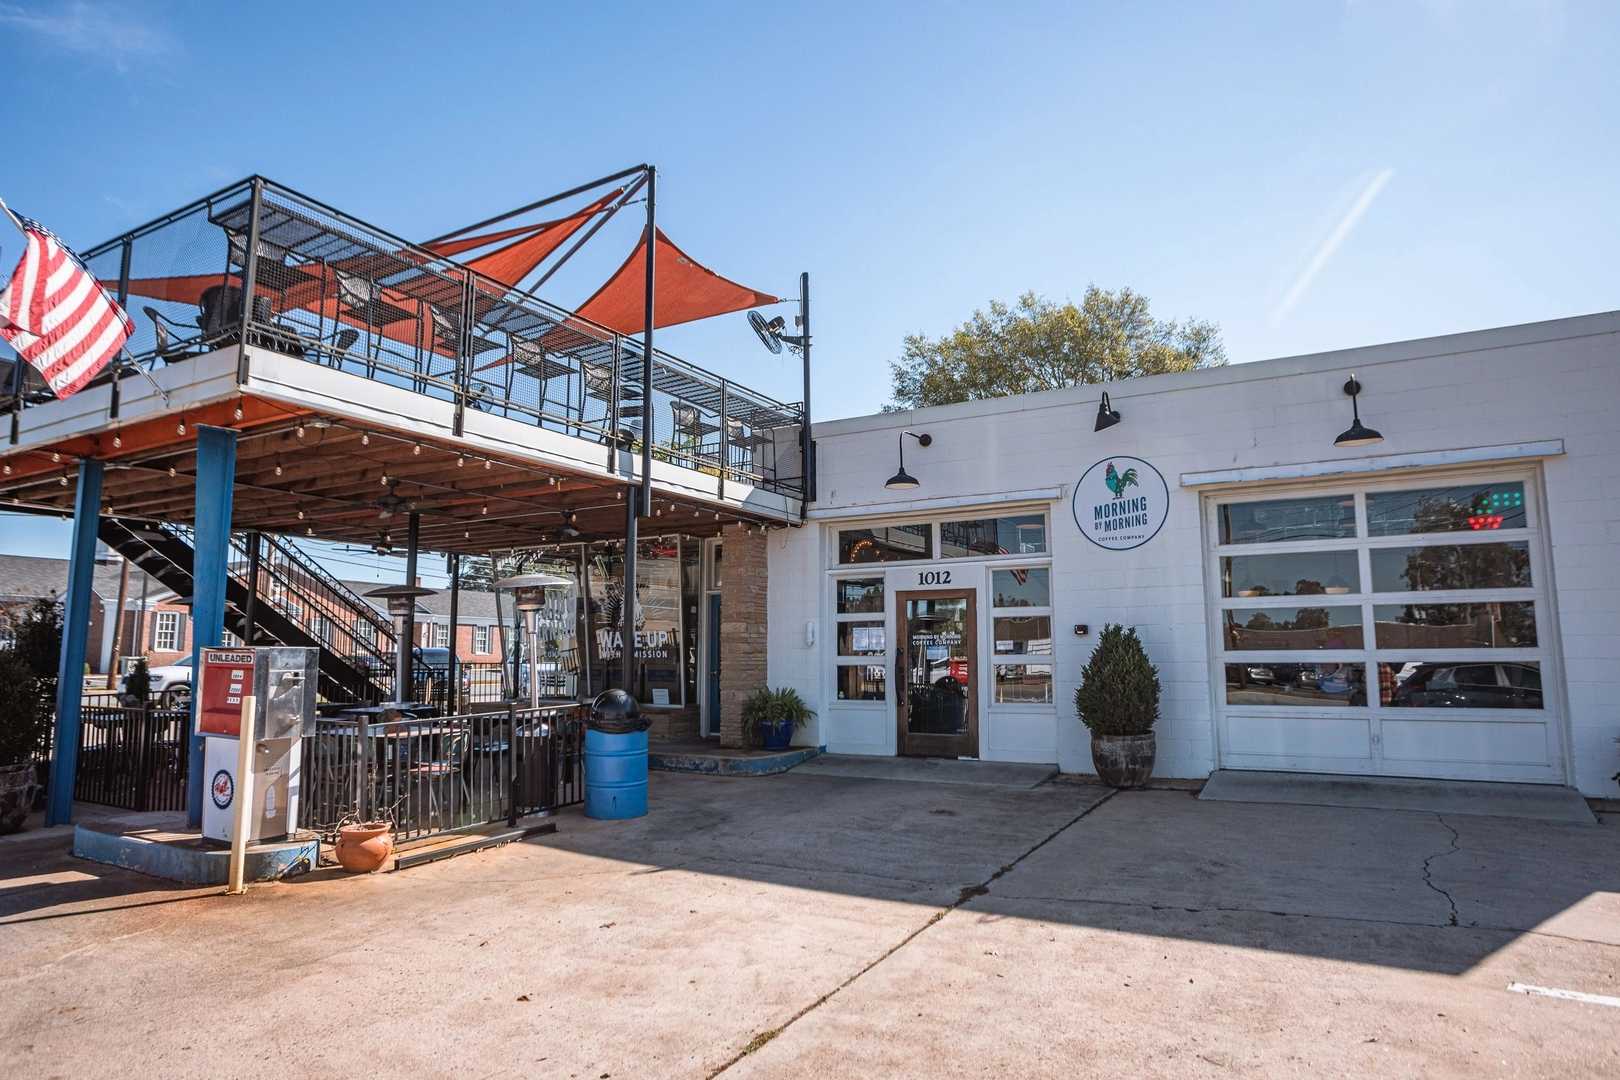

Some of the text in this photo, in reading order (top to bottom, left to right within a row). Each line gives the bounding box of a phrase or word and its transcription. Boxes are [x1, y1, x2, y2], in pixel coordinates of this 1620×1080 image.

[1094, 496, 1147, 520] MORNING
[1094, 513, 1148, 532] BY MORNING
[918, 571, 951, 586] 1012
[600, 630, 667, 648] WAE UP
[209, 653, 253, 663] UNLEADED
